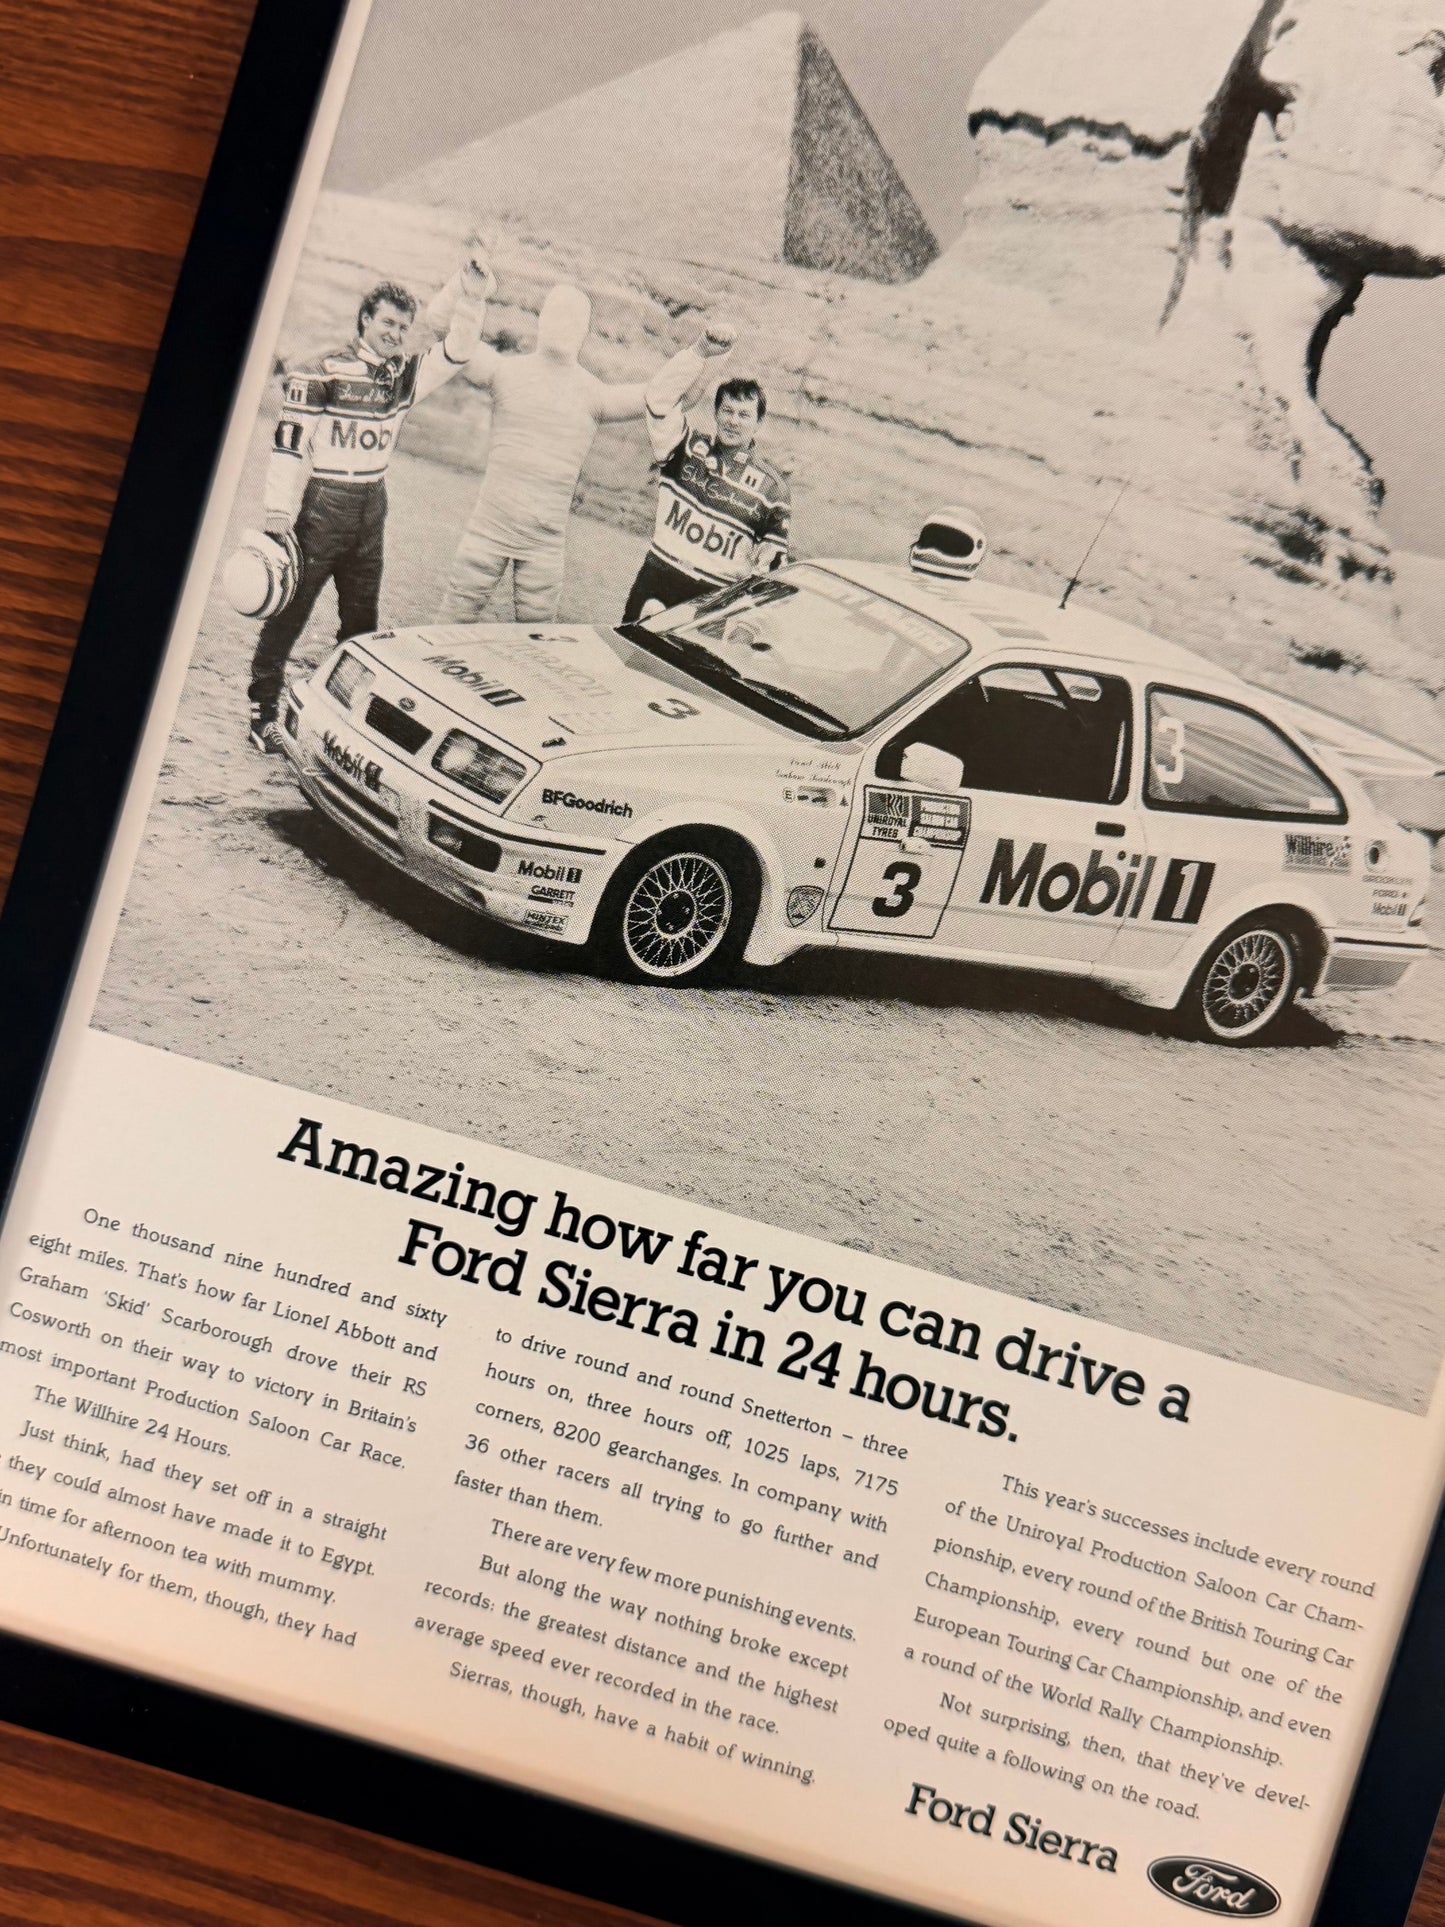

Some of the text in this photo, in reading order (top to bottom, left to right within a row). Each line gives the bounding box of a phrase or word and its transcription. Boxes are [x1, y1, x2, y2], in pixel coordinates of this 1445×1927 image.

[664, 499, 744, 561] Mobil
[421, 654, 505, 693] Mobil
[541, 788, 634, 819] BFGoodrich
[1155, 716, 1185, 785] 3
[517, 860, 565, 882] Mobil
[531, 885, 576, 900] GARRETT
[871, 861, 922, 919] 3
[979, 838, 1158, 919] Mobil
[28, 1233, 439, 1362] eight miles. That's how far Lionel Abbott and
[83, 1208, 448, 1329] One thousand nine hundred and sixty
[277, 1118, 1191, 1423] Amazing how far you can drive a
[9, 1301, 417, 1433] Cosworth on their way to victory in Britain's
[19, 1266, 428, 1397] Graham 'Skid' Scarborough drove their RS
[398, 1219, 1018, 1442] Ford Sierra in 24 hours.
[19, 1419, 387, 1541] Just think, had they set off in a straight
[34, 1384, 231, 1457] The Willhire 24 Hours.
[475, 1402, 888, 1534] corners, 8200 gearchanges. In company with
[484, 1361, 899, 1496] hours on, three hours off, 1025 laps, 7175
[454, 1469, 603, 1527] faster than them.
[464, 1433, 880, 1570] 36 other racers all trying to go further and
[1002, 1473, 1376, 1598] This year's successes include every round
[479, 1554, 849, 1679] But along the way nothing broke except
[945, 1500, 1364, 1632] of the Uniroyal Production Saloon Car Cham-
[925, 1571, 1343, 1705] Championship, every round but one of the
[904, 1647, 1283, 1767] a round of the World Rally Championship.
[939, 1691, 1310, 1810] Not surprising, then, that they've devel-
[905, 1782, 1118, 1873] Ford Sierra
[1169, 1861, 1262, 1913] Ford
